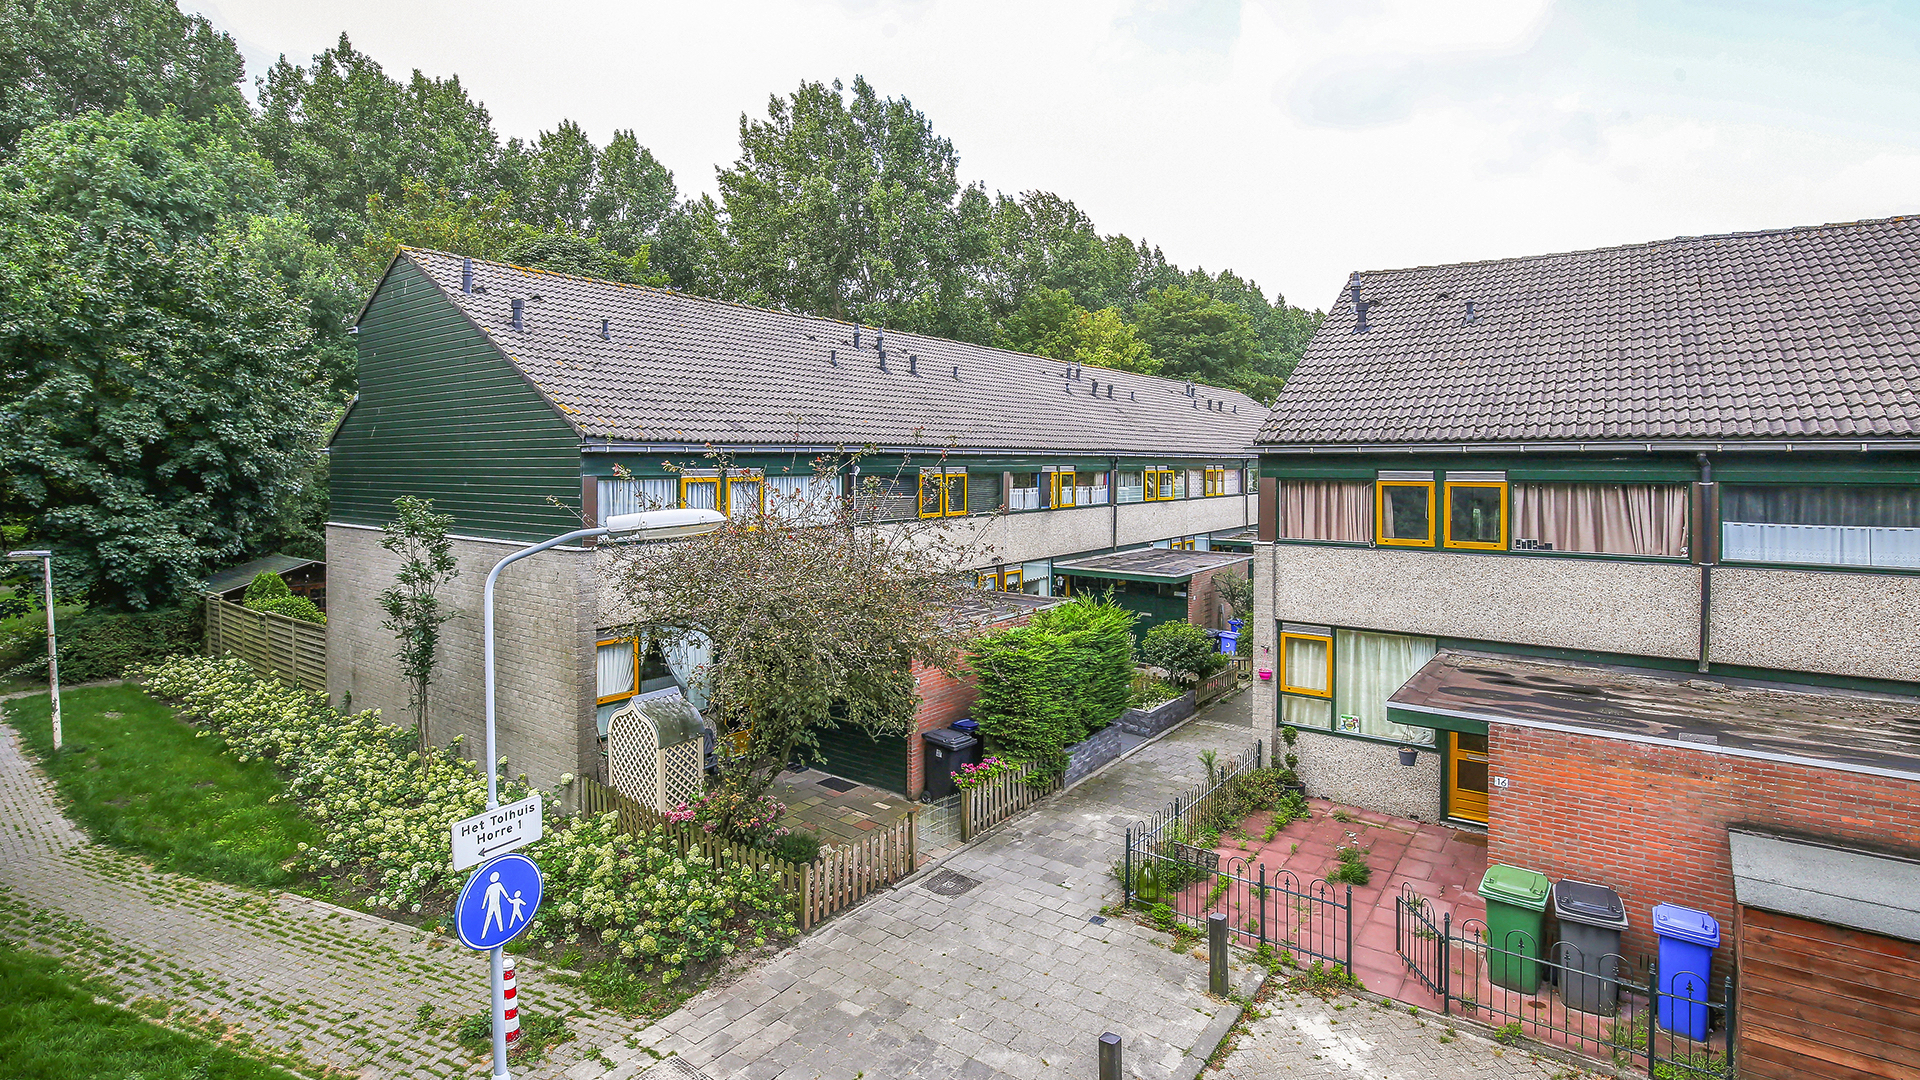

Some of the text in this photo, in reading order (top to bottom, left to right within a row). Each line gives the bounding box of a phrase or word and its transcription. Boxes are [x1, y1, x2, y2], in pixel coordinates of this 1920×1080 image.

[1497, 778, 1507, 787] 16
[461, 804, 535, 837] Het Tolhuis
[477, 819, 522, 845] Horre 1
